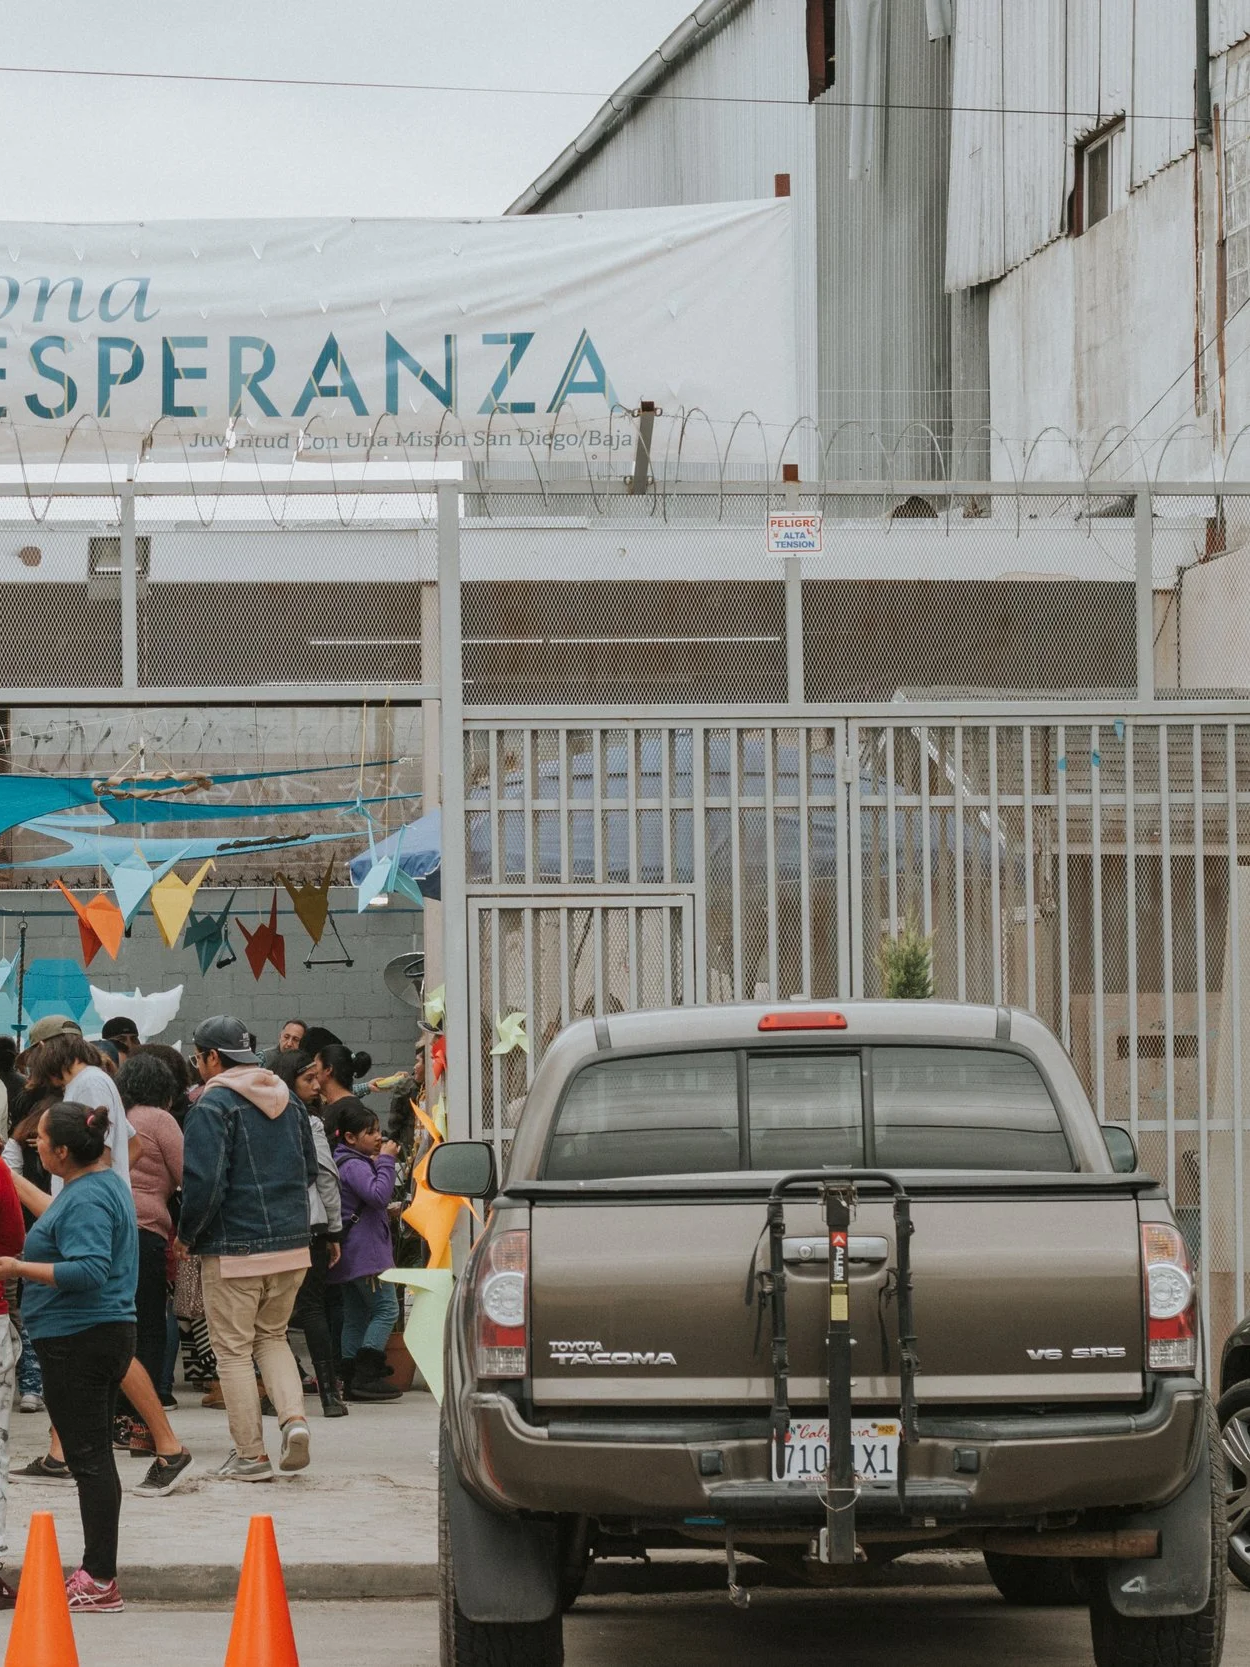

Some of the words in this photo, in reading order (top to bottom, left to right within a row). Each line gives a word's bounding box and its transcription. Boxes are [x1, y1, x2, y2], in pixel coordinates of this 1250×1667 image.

[298, 433, 338, 450] Con
[346, 432, 388, 448] Una
[395, 430, 467, 448] Misión
[473, 431, 512, 447] San
[519, 430, 633, 451] Diego/Baja
[783, 531, 806, 539] ALTA
[775, 540, 815, 548] TENSION
[548, 1341, 604, 1352] TOYOTA
[549, 1352, 678, 1365] TACOMA
[1026, 1348, 1063, 1360] V6
[1070, 1347, 1127, 1359] SR5
